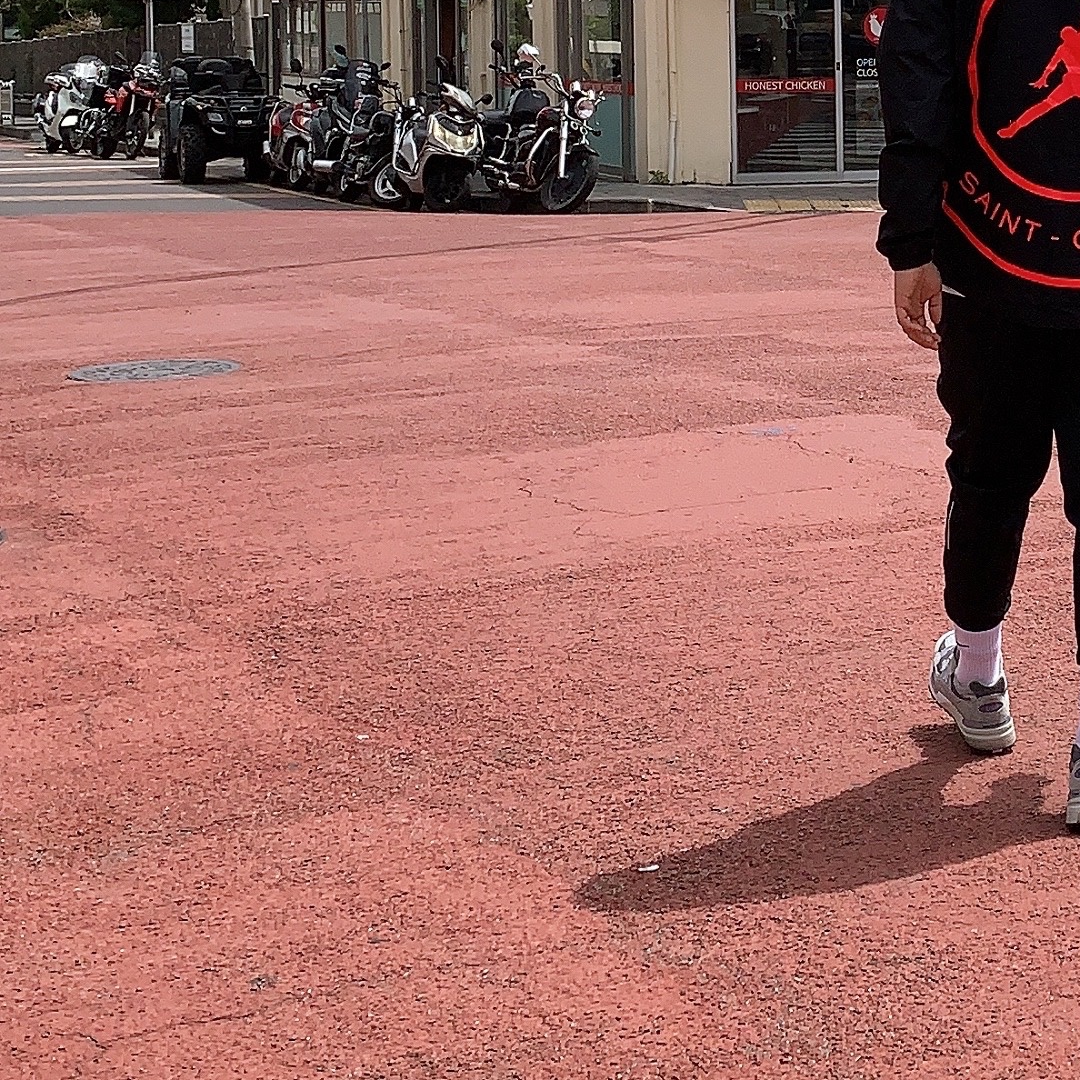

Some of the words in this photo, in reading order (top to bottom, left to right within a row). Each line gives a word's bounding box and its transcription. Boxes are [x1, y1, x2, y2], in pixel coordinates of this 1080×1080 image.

[856, 68, 879, 77] CLOS
[744, 81, 784, 91] HONEST
[784, 80, 826, 91] CHICKEN
[958, 171, 1042, 242] SAINT
